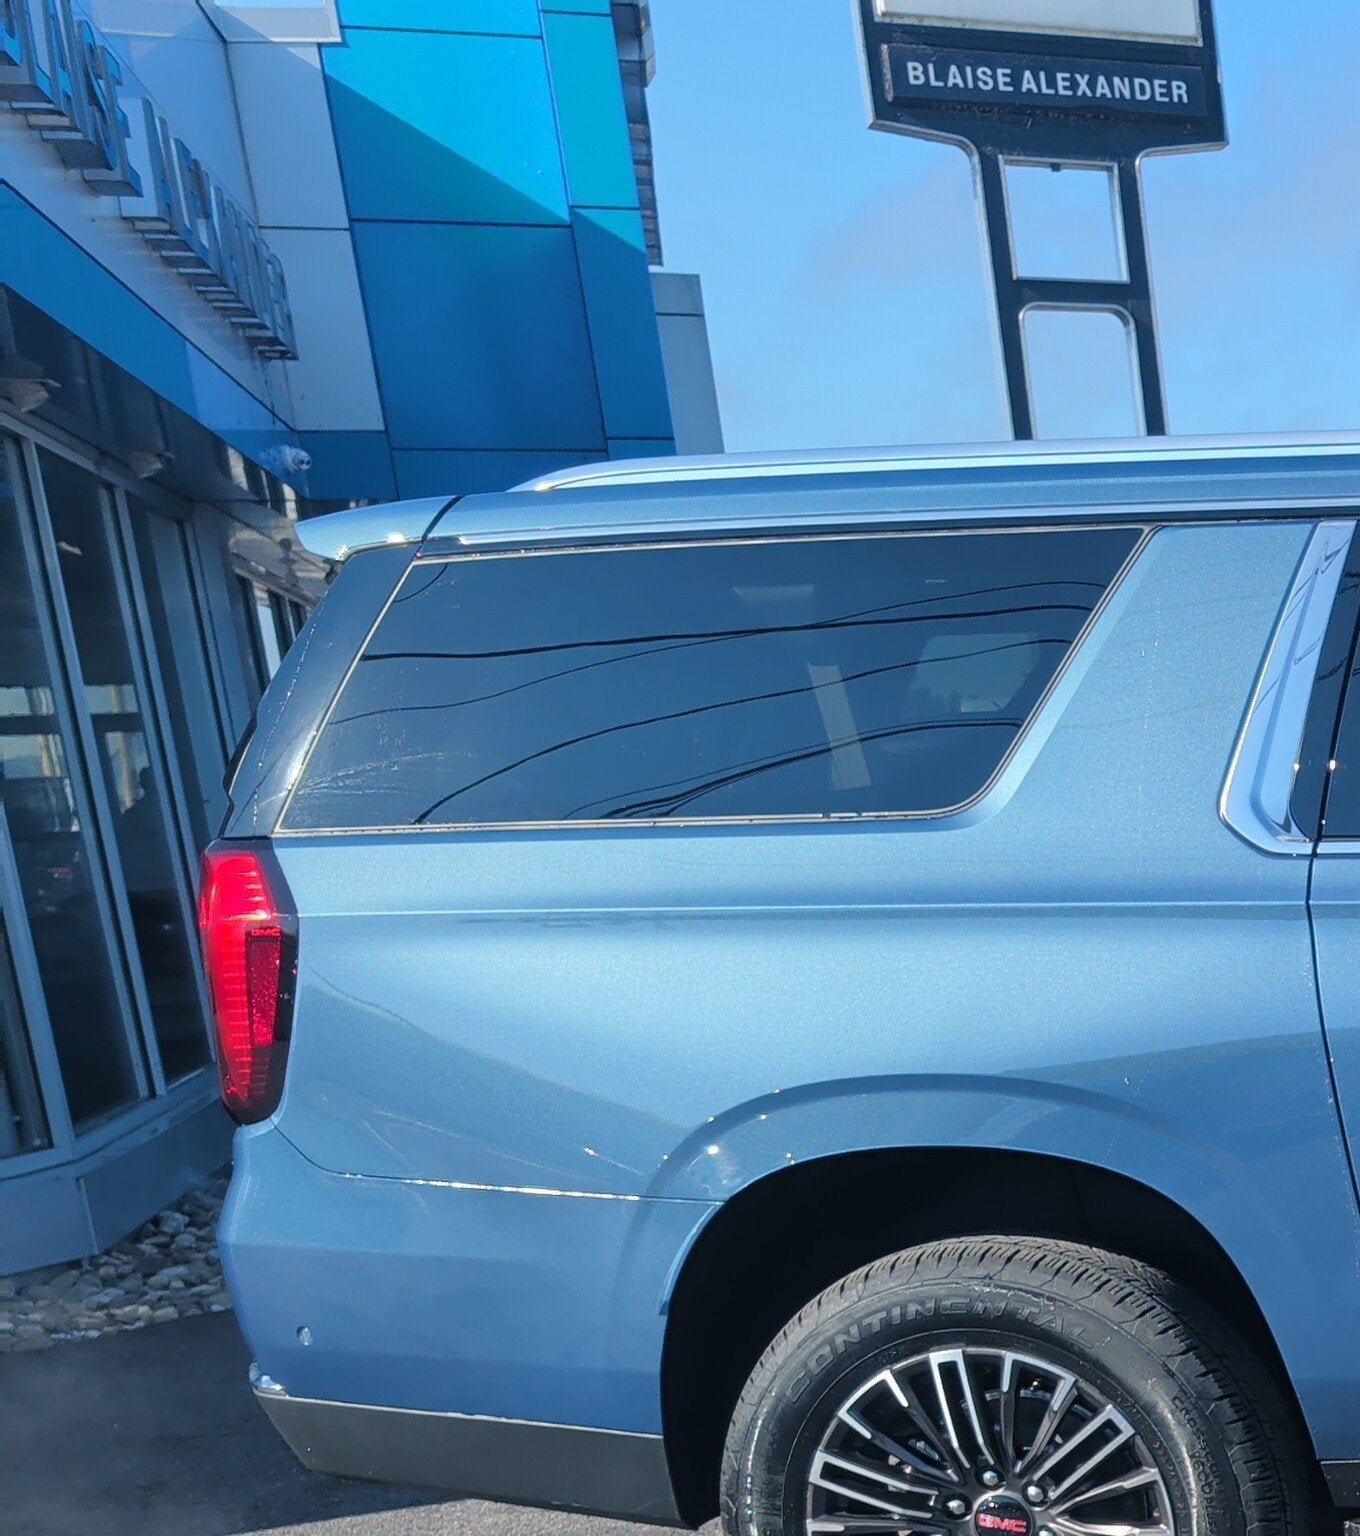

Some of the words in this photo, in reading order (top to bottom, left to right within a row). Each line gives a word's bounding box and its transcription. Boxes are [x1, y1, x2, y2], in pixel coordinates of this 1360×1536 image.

[906, 61, 1014, 93] BLAISE
[1020, 70, 1189, 104] ALEXANDER
[788, 1297, 1096, 1402] CONTINENTAL
[978, 1513, 1027, 1534] GMC
